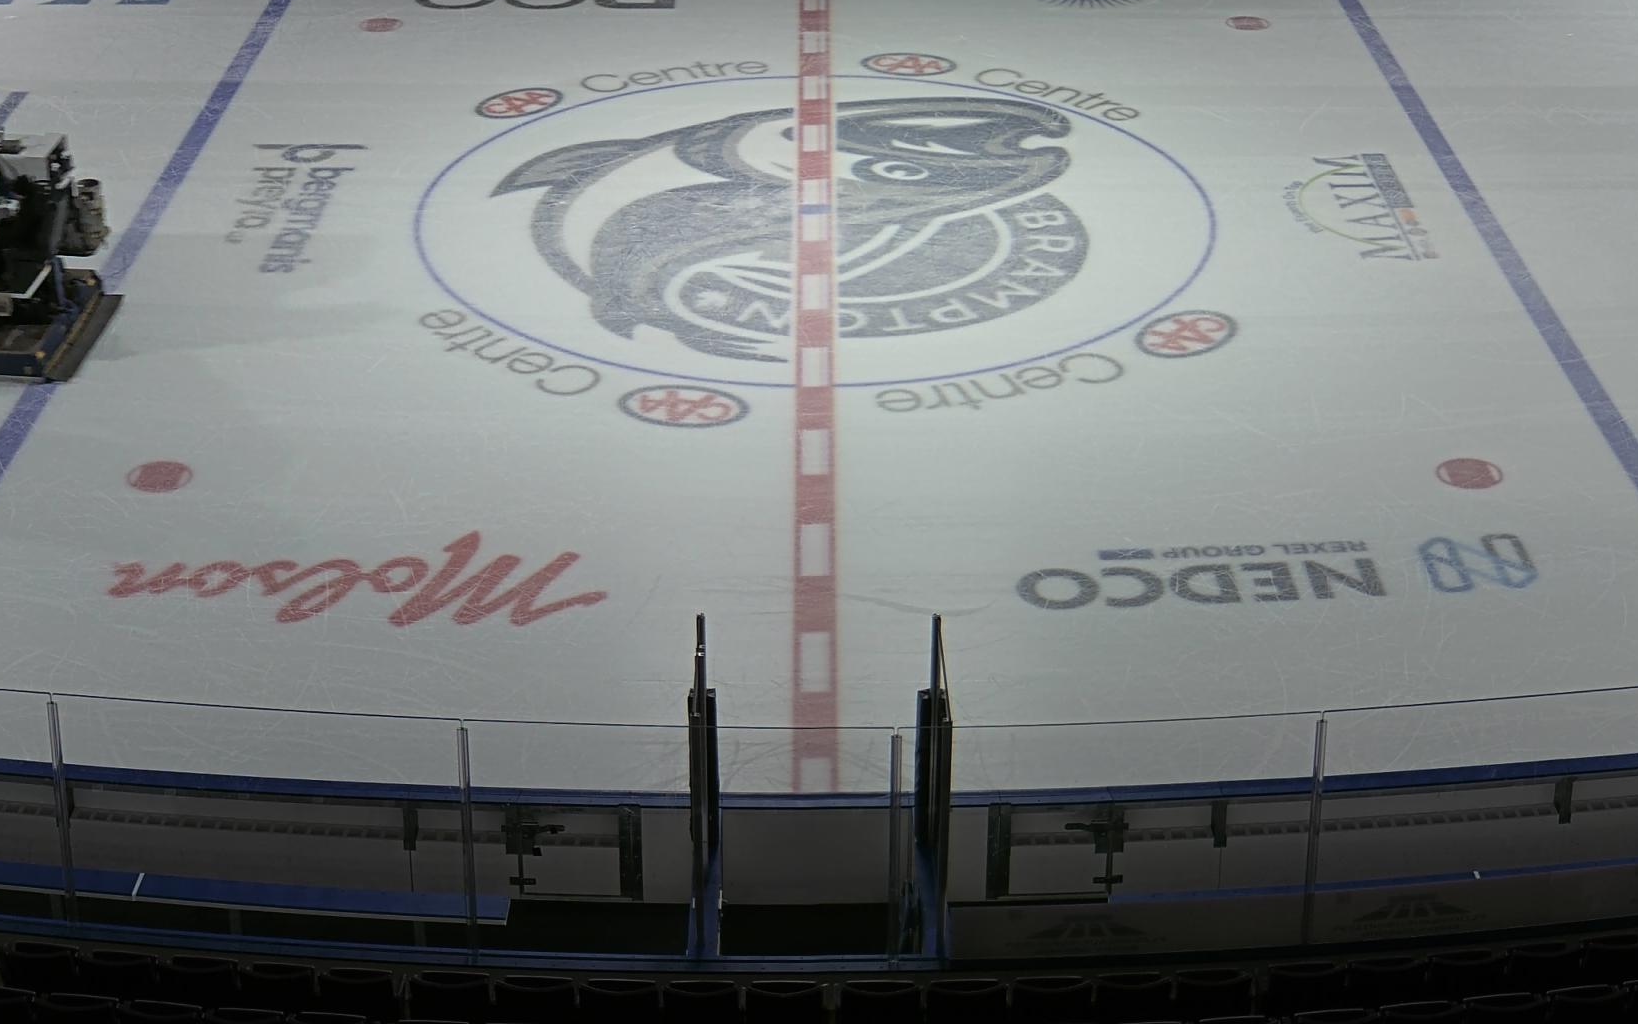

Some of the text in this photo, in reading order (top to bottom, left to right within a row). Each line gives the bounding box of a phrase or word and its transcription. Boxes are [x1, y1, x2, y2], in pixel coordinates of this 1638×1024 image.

[486, 60, 770, 116] CAA Centre
[873, 54, 1141, 122] CAA Centre
[237, 166, 294, 231] preyra
[259, 166, 355, 274] bergmanis
[1312, 153, 1417, 261] MAXIM
[418, 308, 732, 422] CAA Centre
[875, 314, 1225, 413] CAA Centre
[110, 529, 608, 628] Molson
[1017, 559, 1387, 610] NEDCO
[1159, 537, 1368, 562] REXEL GROUP
